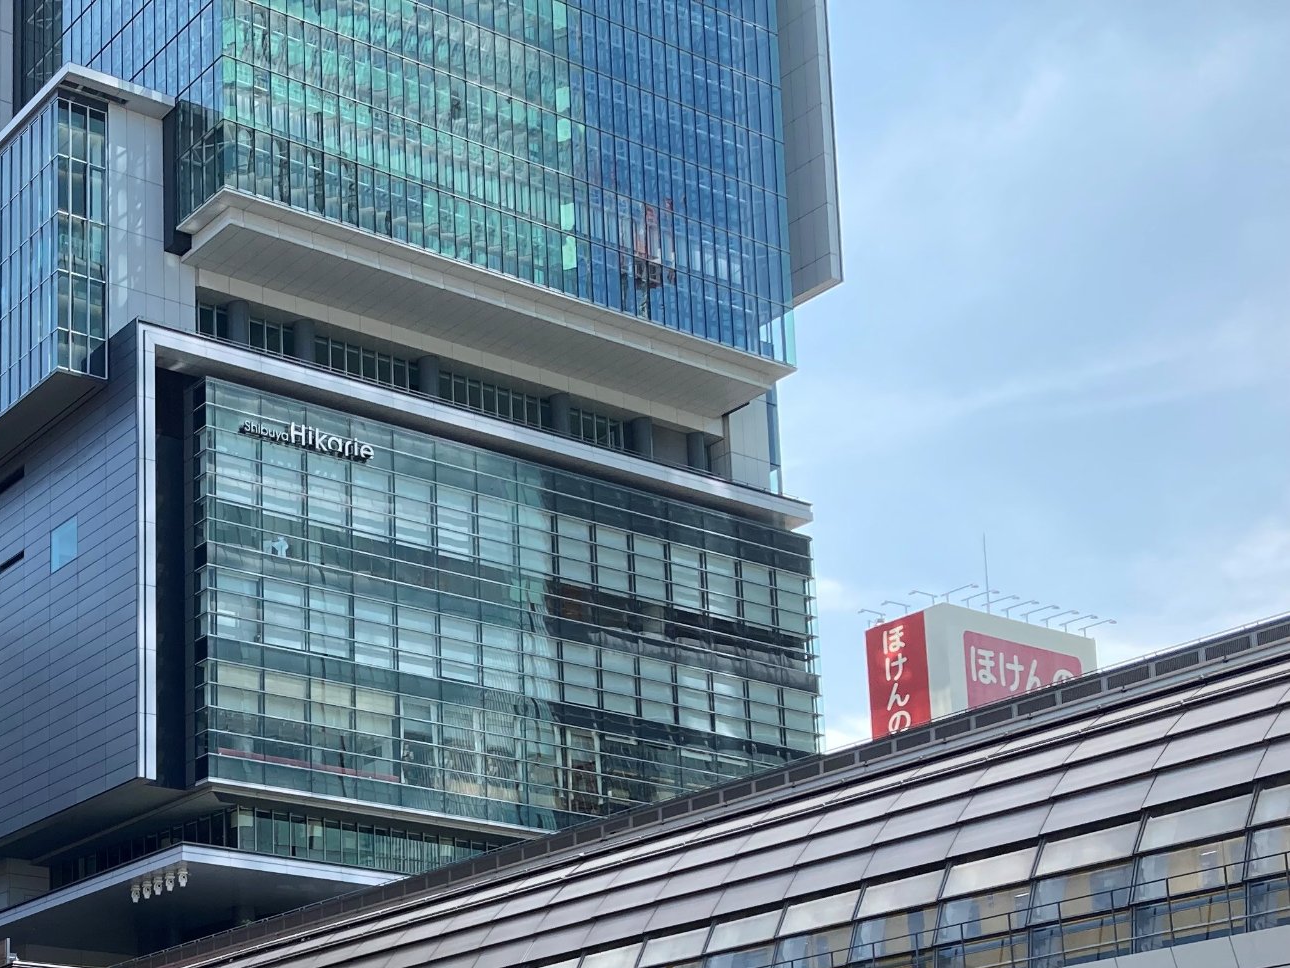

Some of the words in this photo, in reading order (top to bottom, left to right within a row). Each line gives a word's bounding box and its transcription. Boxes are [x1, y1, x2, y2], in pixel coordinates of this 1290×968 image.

[244, 419, 289, 441] Shibuya
[290, 422, 375, 459] Hikarie
[883, 625, 911, 733] ほけんの
